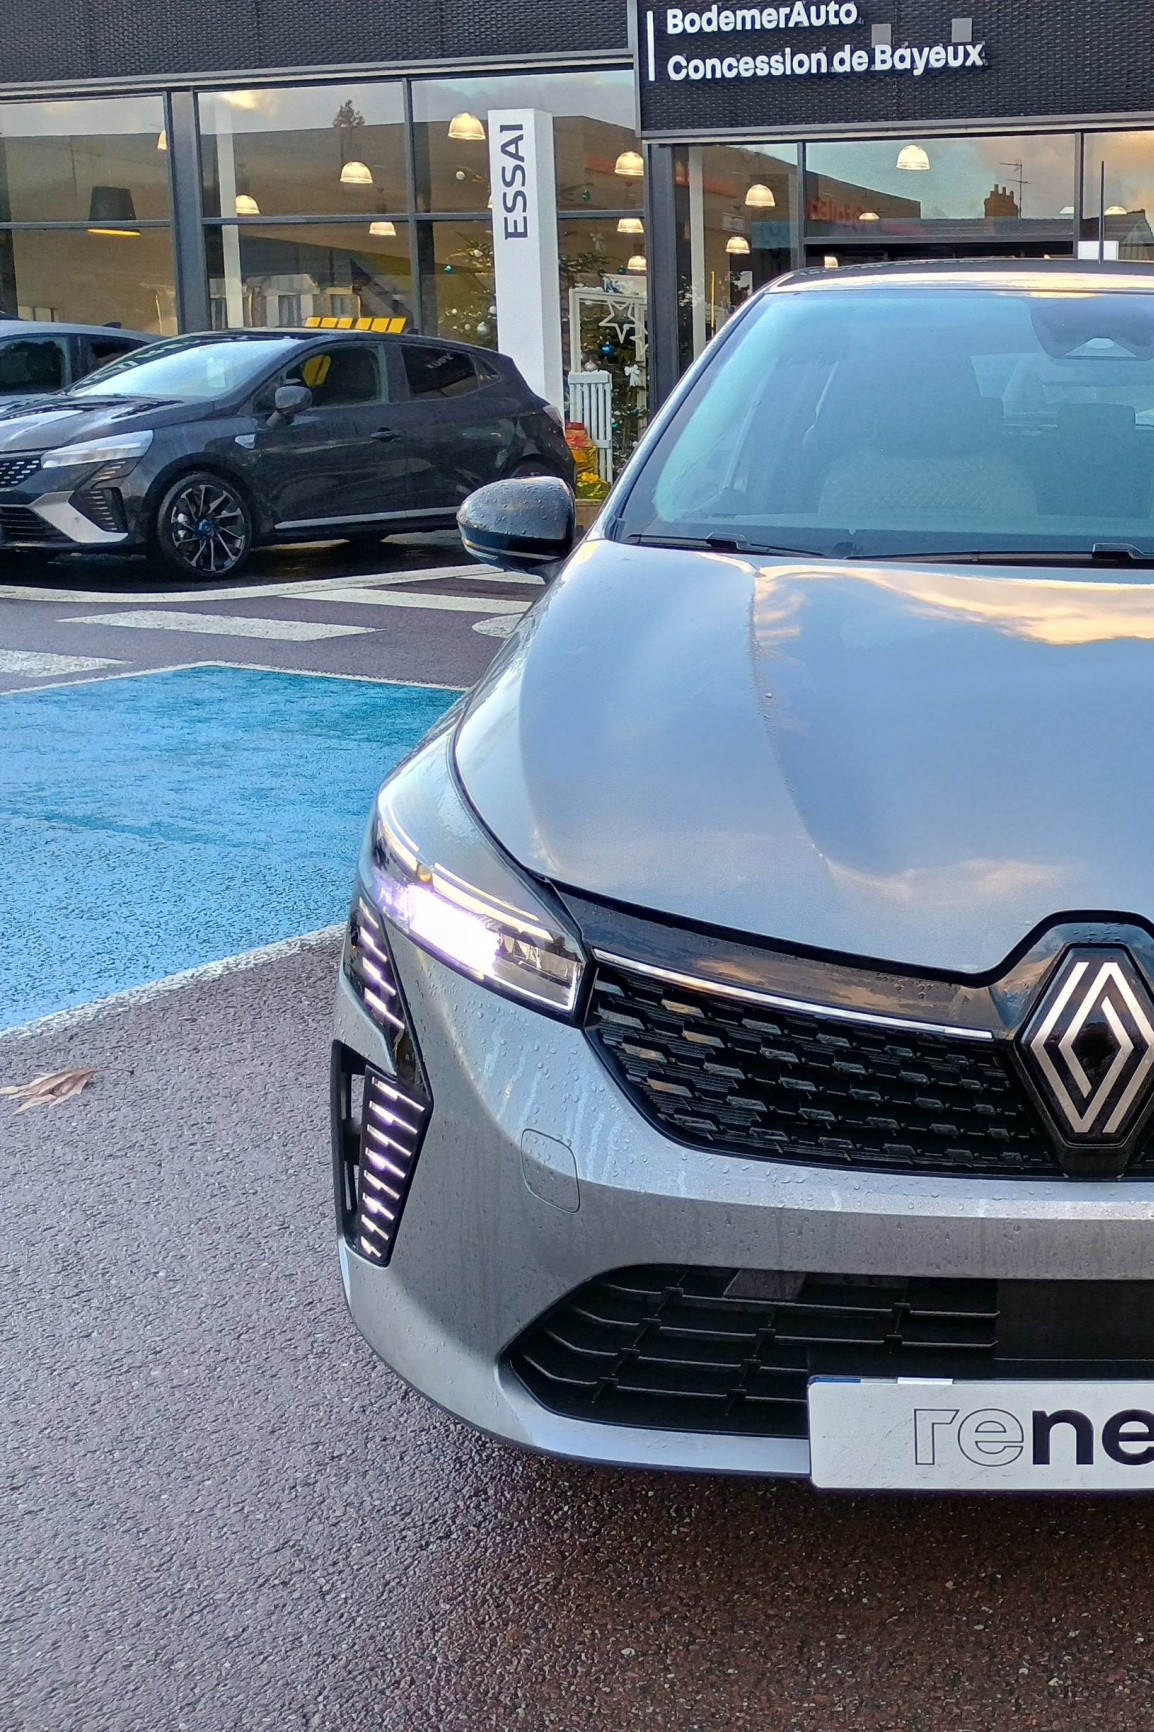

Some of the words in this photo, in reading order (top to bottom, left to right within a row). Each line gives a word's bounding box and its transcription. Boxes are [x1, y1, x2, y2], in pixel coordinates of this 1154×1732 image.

[667, 1, 858, 35] BodemerAuto
[667, 48, 827, 81] Concession
[833, 44, 868, 71] de
[875, 43, 984, 76] Bayeux
[500, 124, 528, 240] ESSAI
